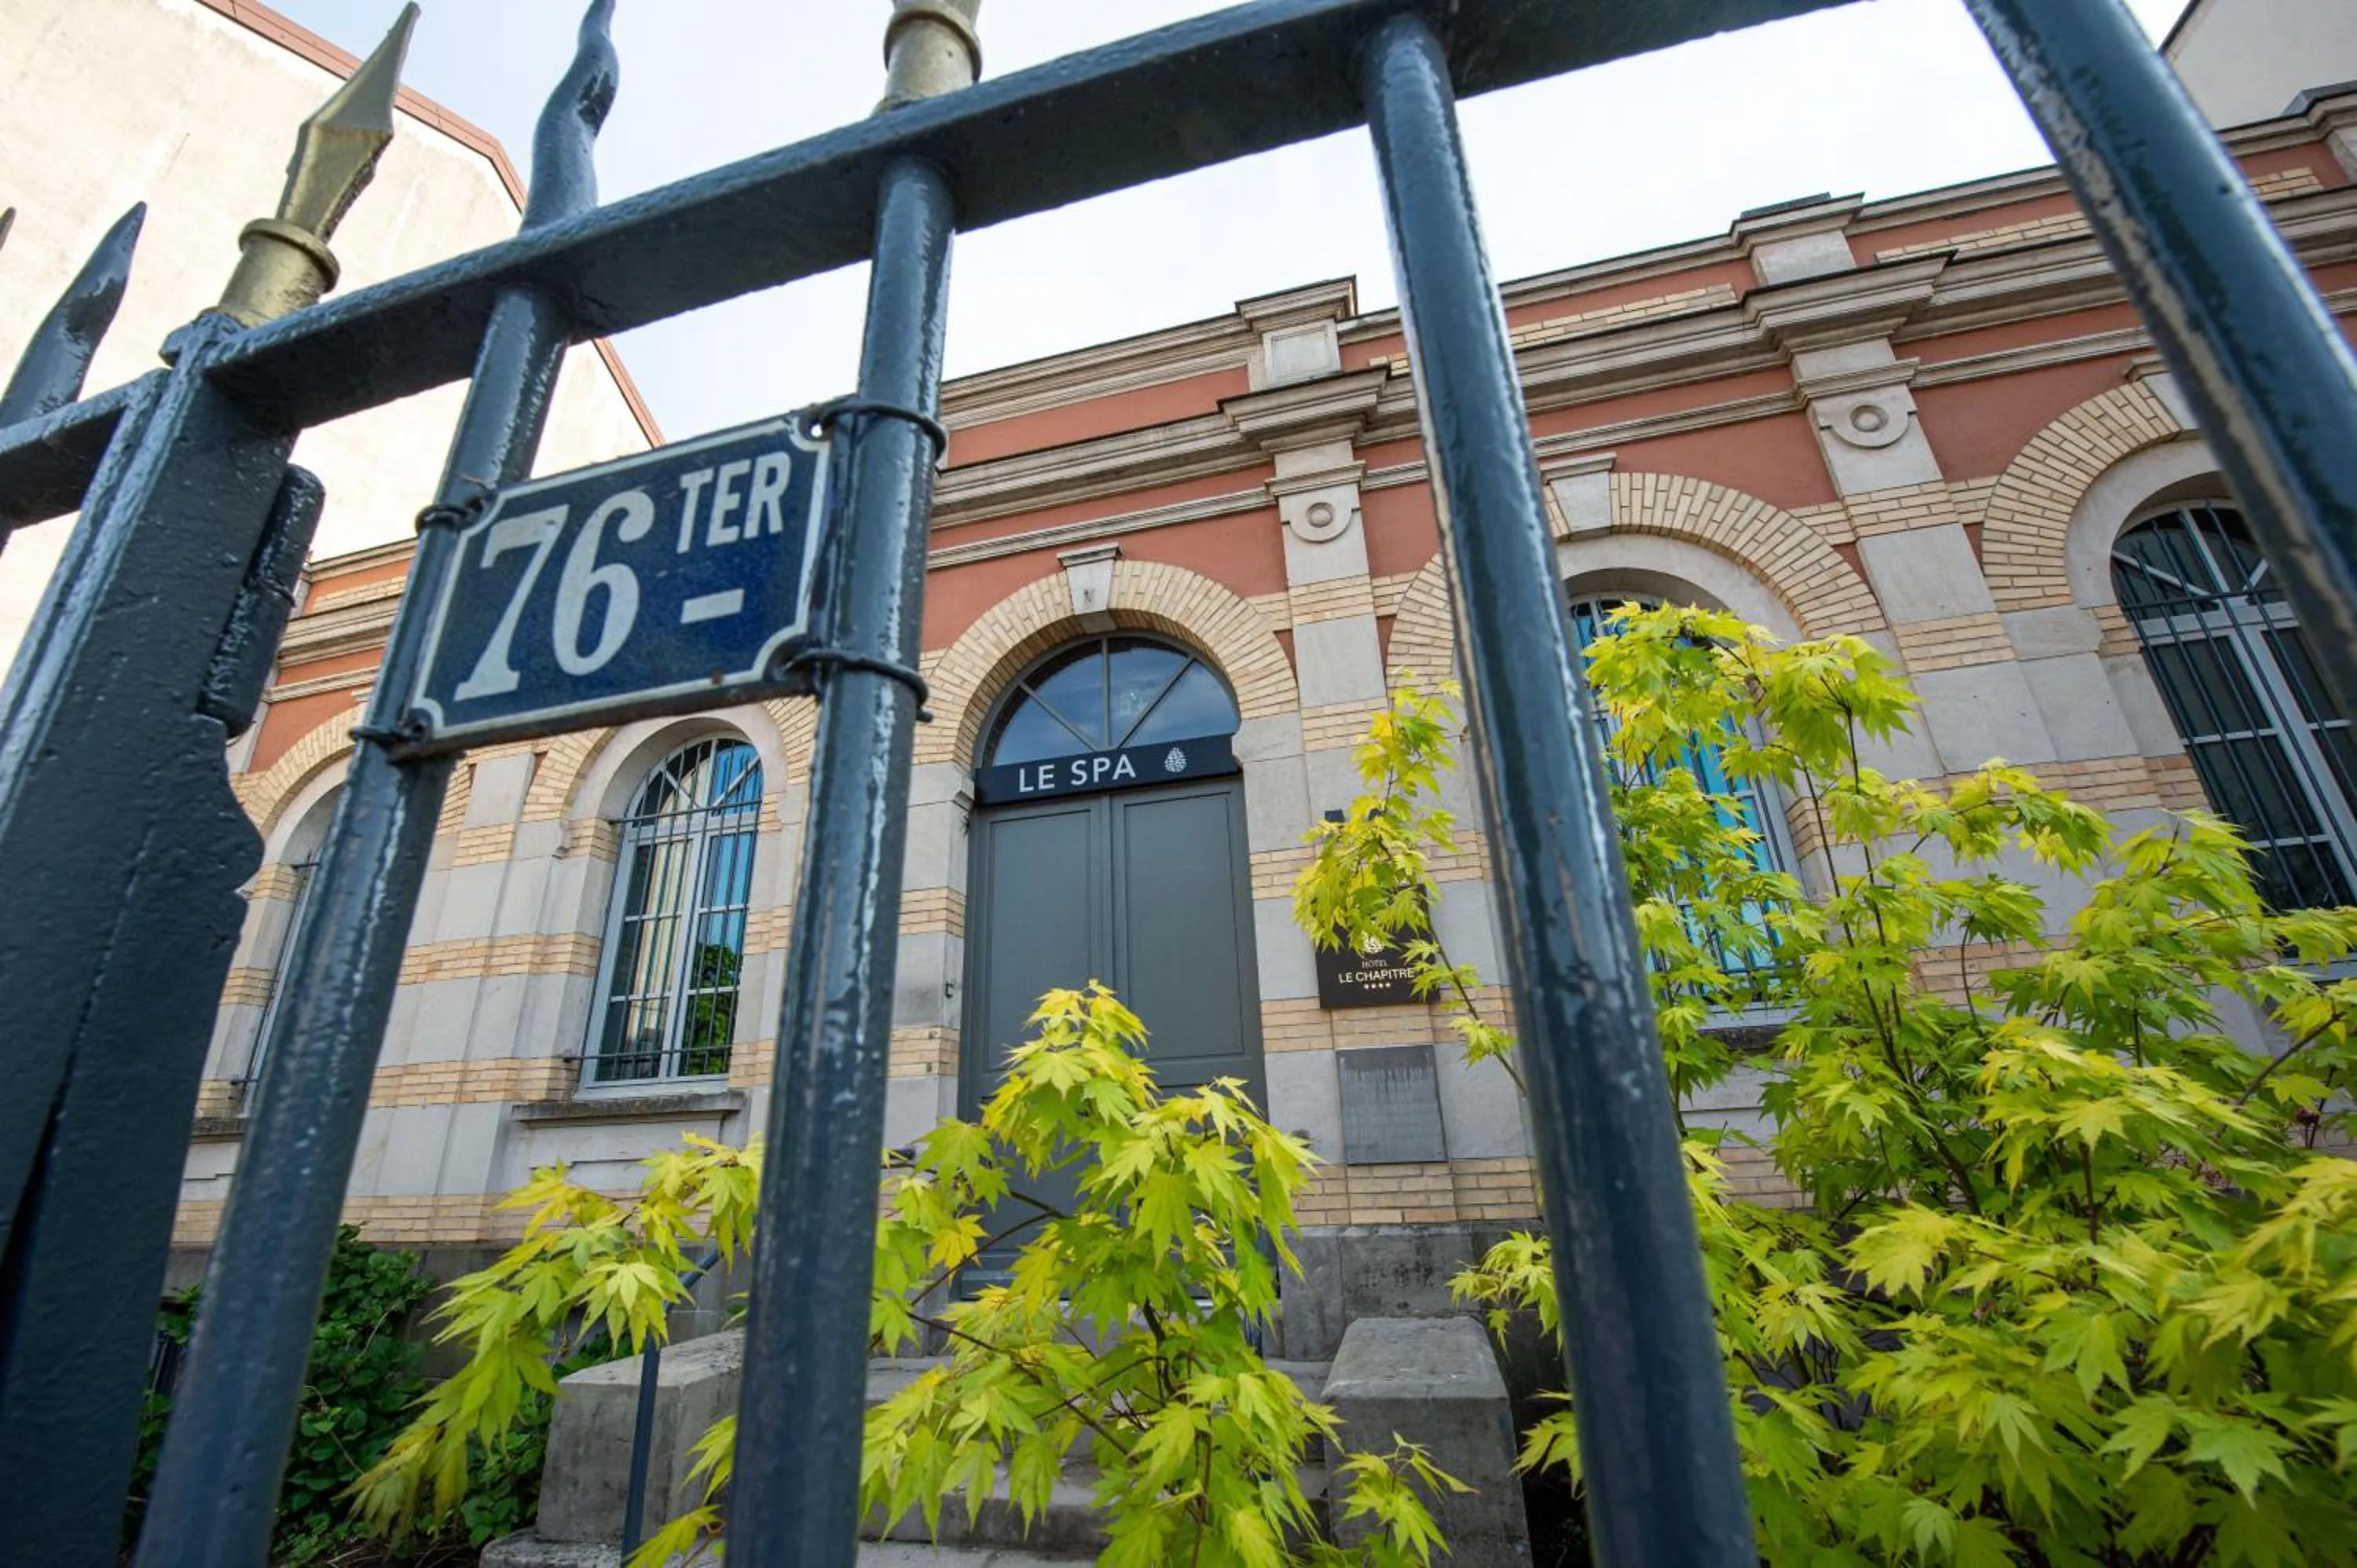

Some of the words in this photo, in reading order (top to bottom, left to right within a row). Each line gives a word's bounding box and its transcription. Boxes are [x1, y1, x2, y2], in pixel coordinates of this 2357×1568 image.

[454, 489, 656, 702] 76
[676, 451, 791, 553] TER
[1019, 764, 1055, 792] LE
[1071, 753, 1136, 786] SPA
[1339, 972, 1353, 983] LE
[1355, 968, 1414, 982] CHAPITRE
